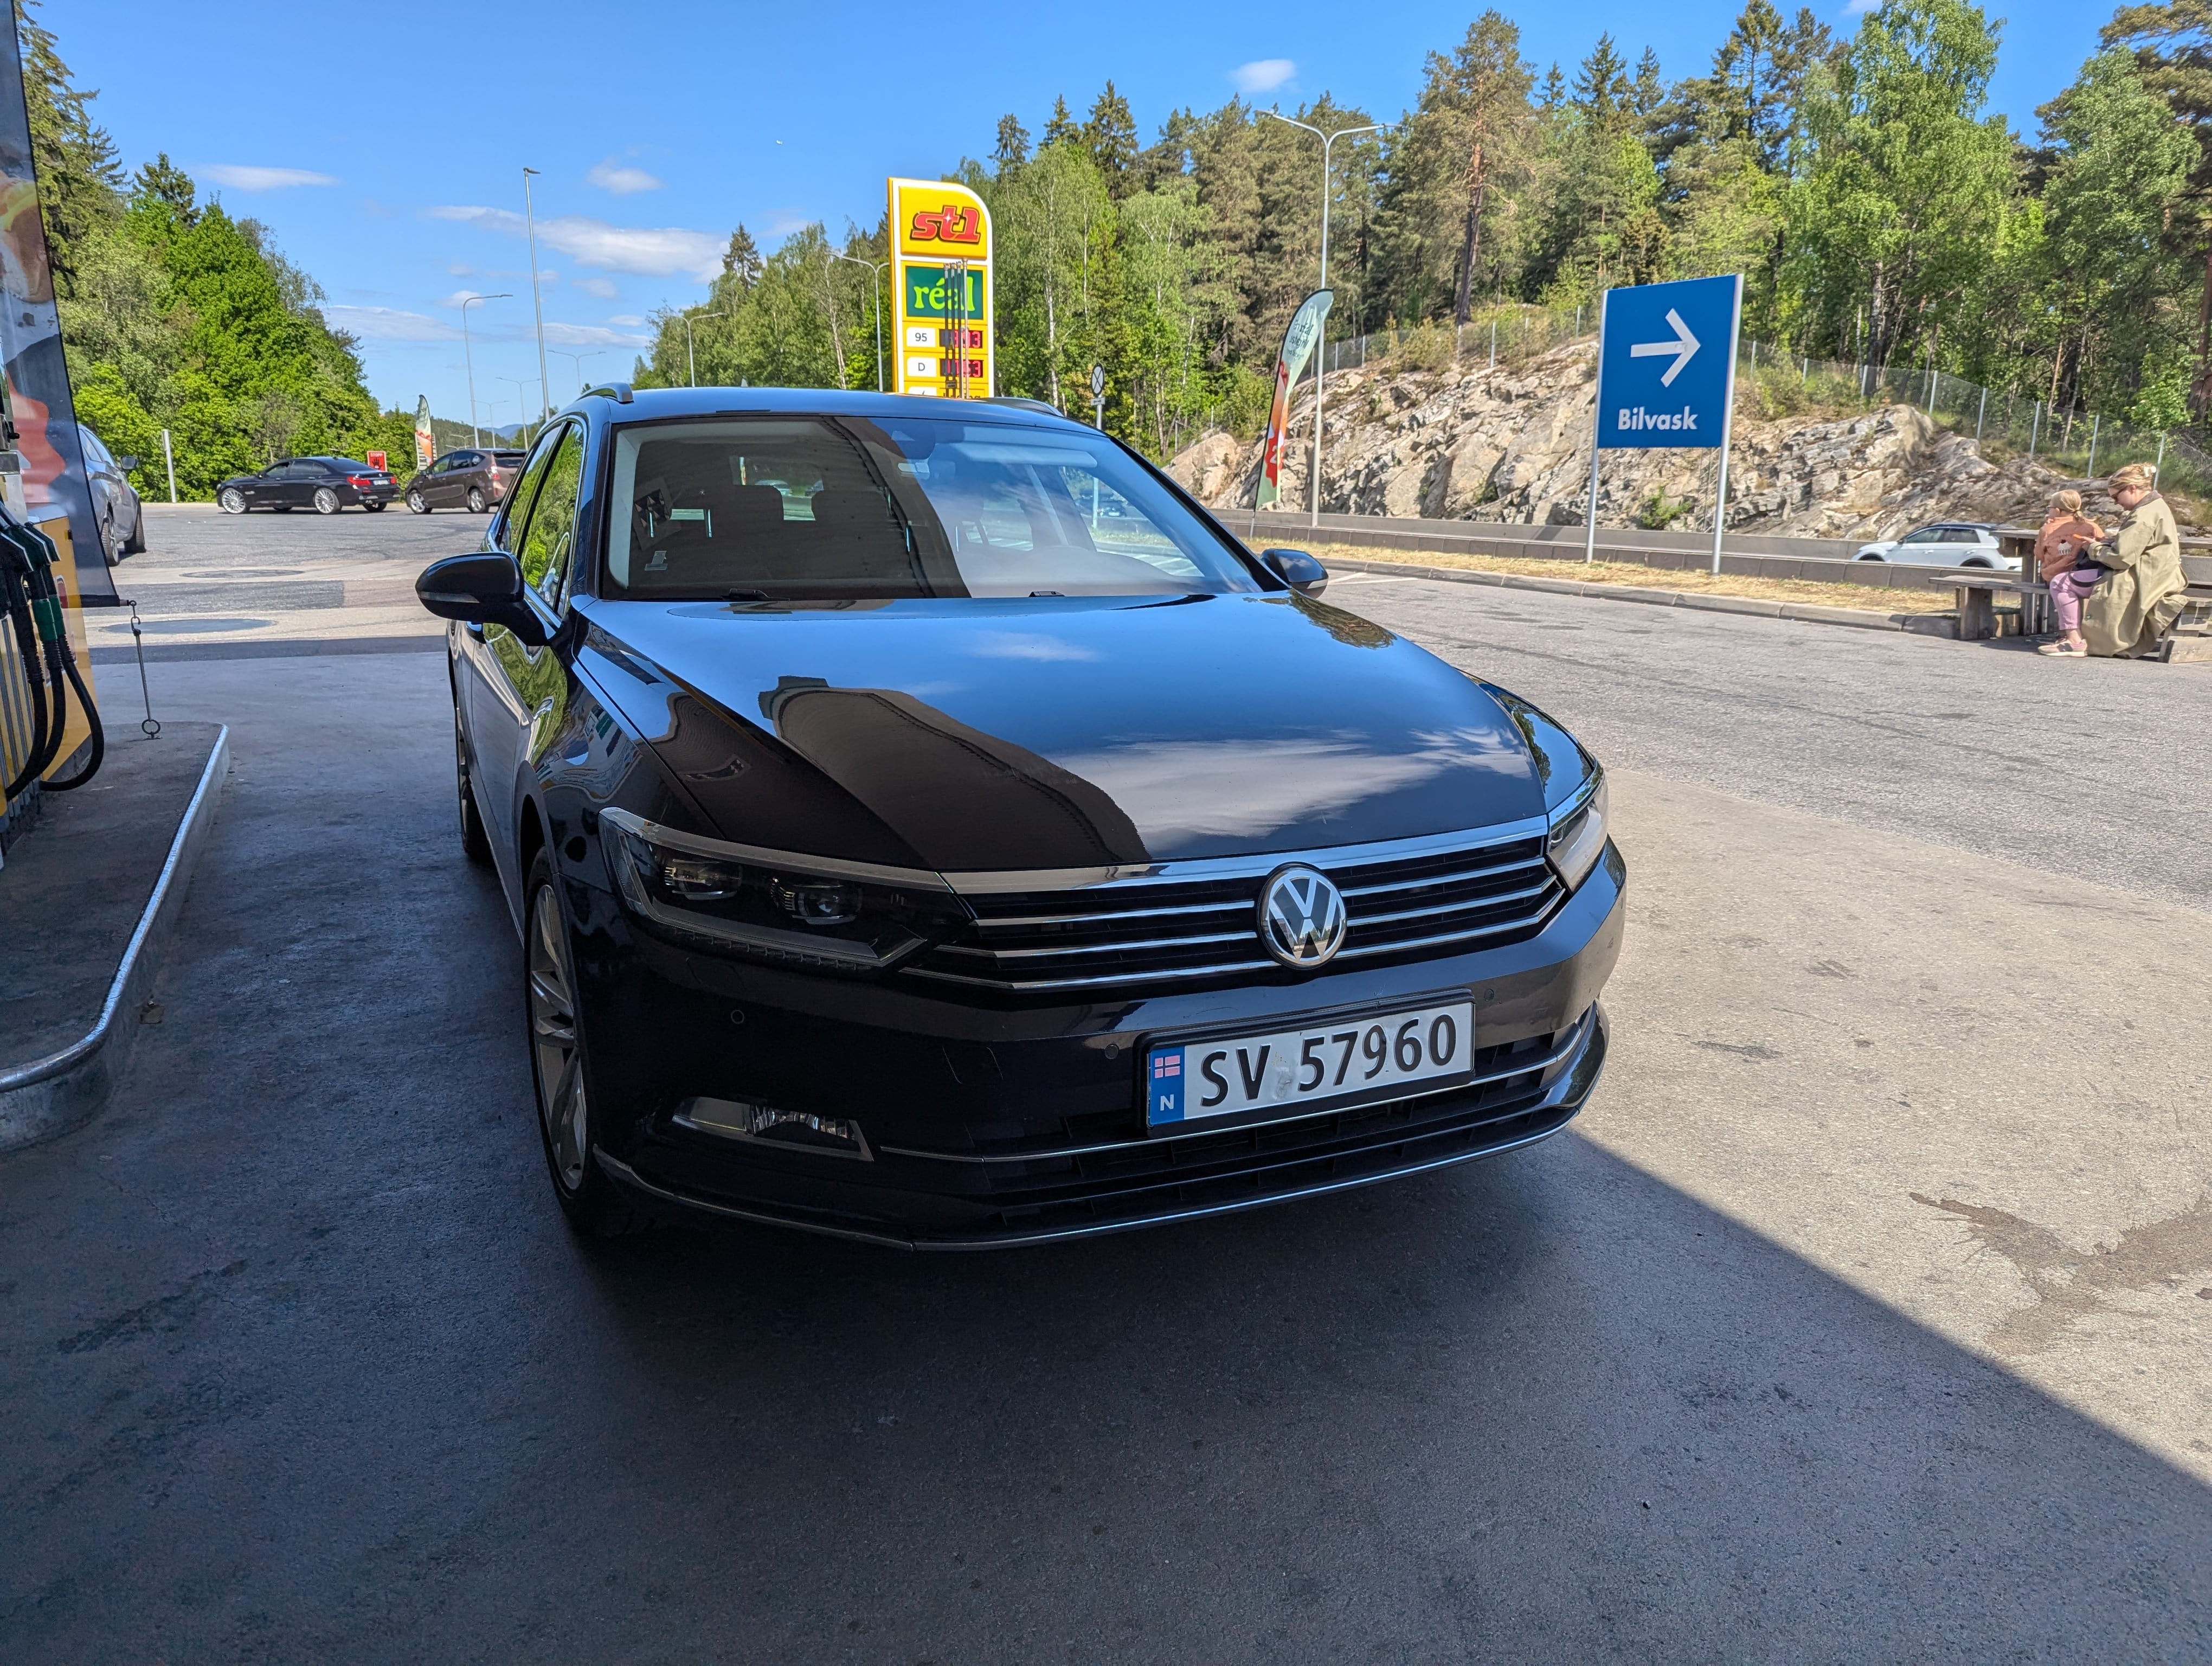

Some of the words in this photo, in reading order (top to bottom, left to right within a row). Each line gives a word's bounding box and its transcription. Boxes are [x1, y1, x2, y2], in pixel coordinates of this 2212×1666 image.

[910, 205, 981, 244] st1
[914, 276, 975, 311] réal
[915, 332, 927, 342] 95
[918, 362, 925, 371] D
[1618, 406, 1698, 430] Bilvask
[1200, 1044, 1271, 1107] SV
[1297, 1014, 1457, 1092] 57960
[1160, 1094, 1174, 1111] N
